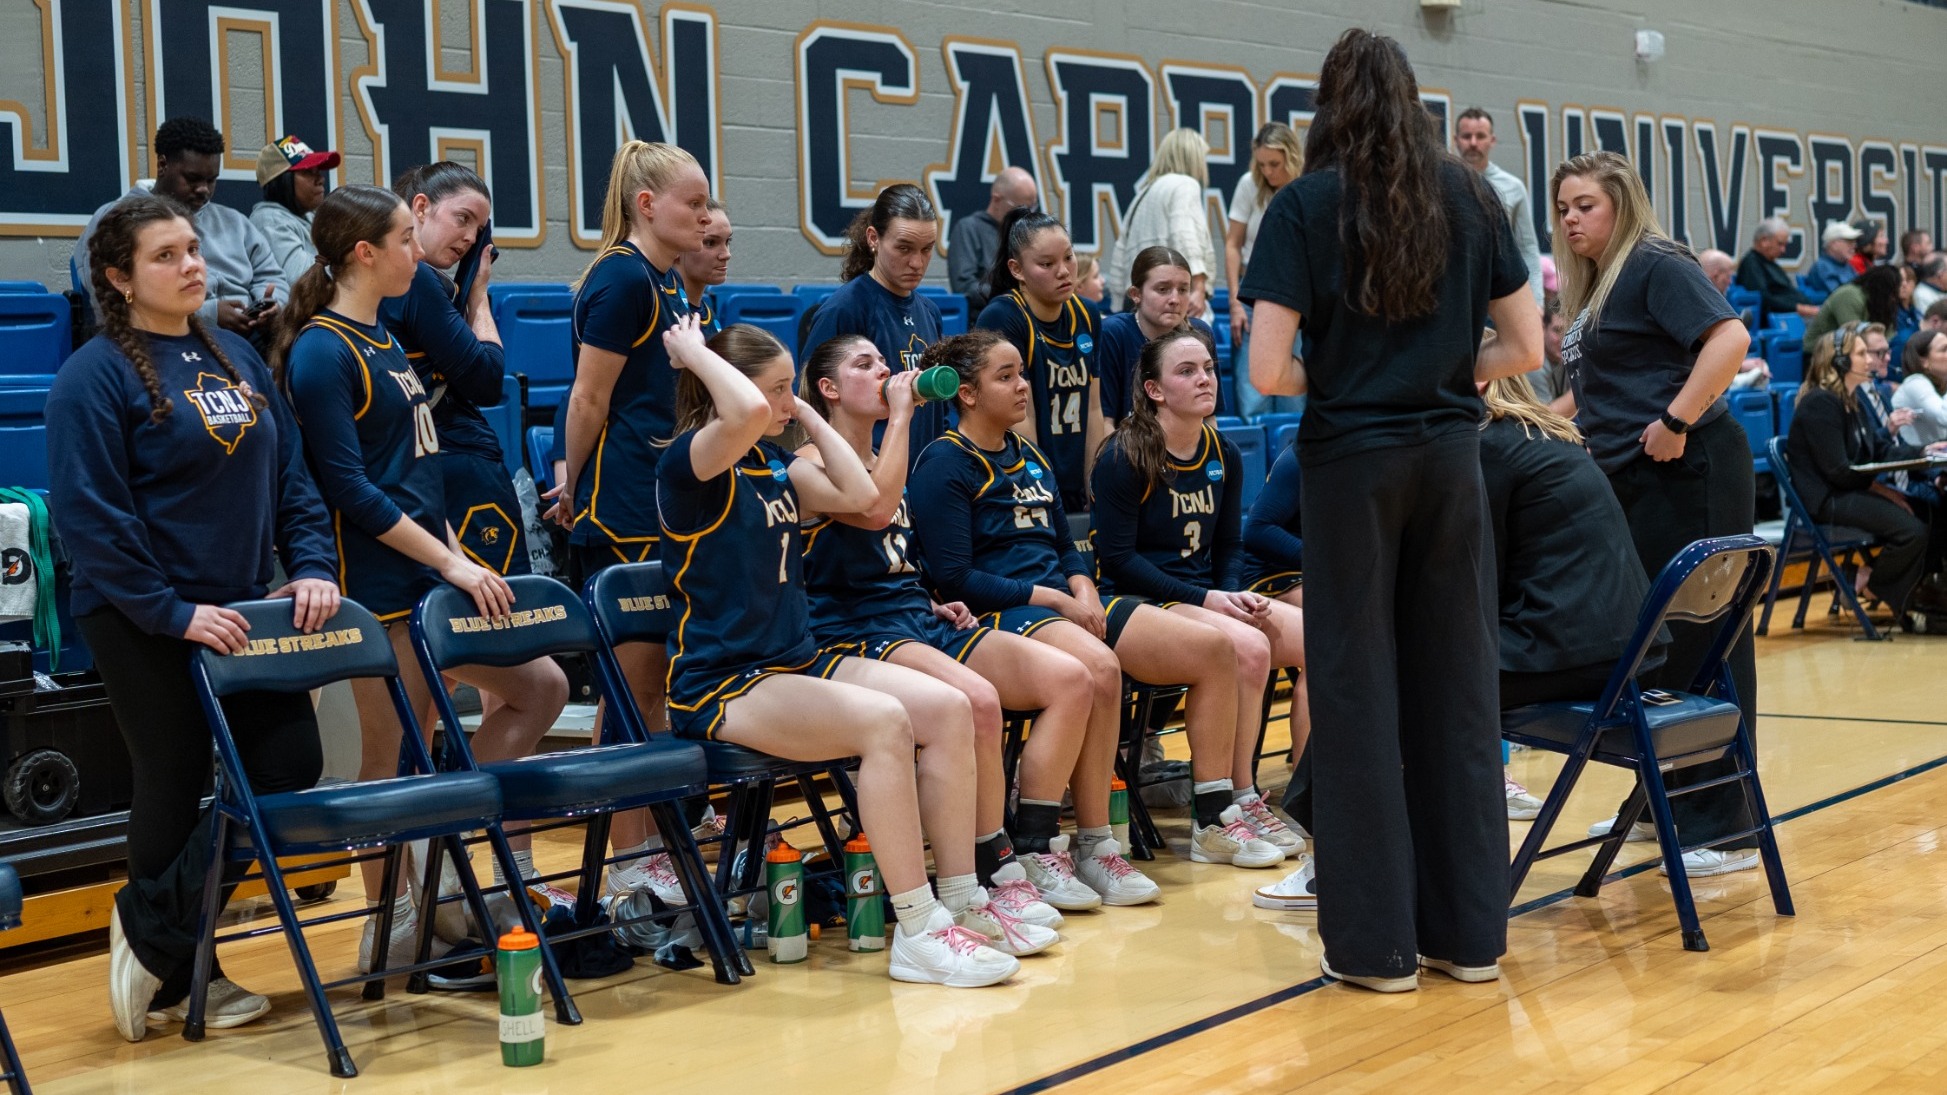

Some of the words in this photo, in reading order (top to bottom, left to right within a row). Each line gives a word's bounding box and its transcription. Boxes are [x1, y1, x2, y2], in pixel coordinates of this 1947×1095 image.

[0, 0, 727, 249] JOHN
[1047, 357, 1087, 389] TCNJ
[190, 389, 249, 414] TCNJ
[1051, 391, 1081, 434] 14
[206, 413, 251, 425] BASKETBALL
[414, 402, 439, 458] 10
[1169, 484, 1214, 518] TCNJ
[1181, 521, 1201, 558] 3
[778, 532, 790, 583] 1
[449, 615, 491, 633] BLUE
[491, 605, 568, 630] STREAKS
[618, 597, 655, 612] BLUE
[233, 638, 278, 656] LUE
[278, 627, 363, 653] STREAKS
[775, 878, 798, 905] G
[853, 869, 875, 894] G
